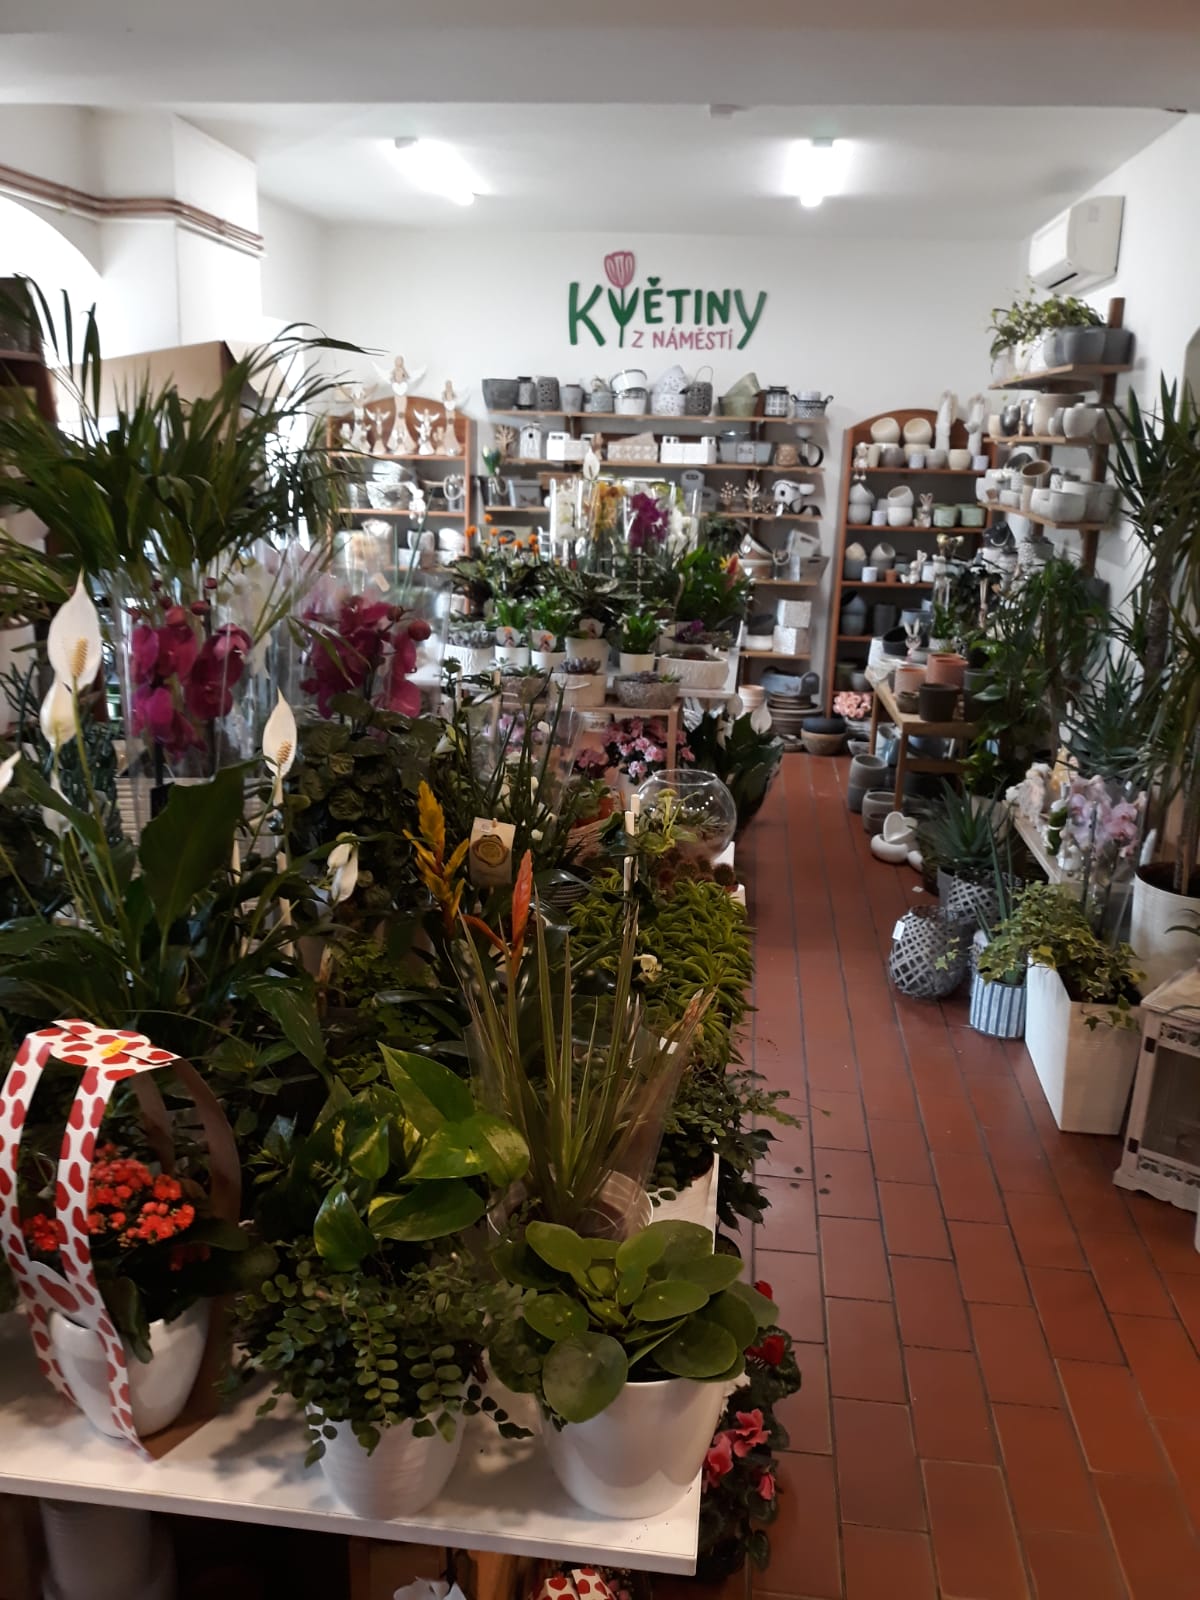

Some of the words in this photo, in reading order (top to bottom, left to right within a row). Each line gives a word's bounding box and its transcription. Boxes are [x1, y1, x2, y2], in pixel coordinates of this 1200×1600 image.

[568, 276, 768, 350] KVĚTINY
[631, 330, 645, 348] Z
[652, 327, 733, 350] NÁMĚSTÍ
